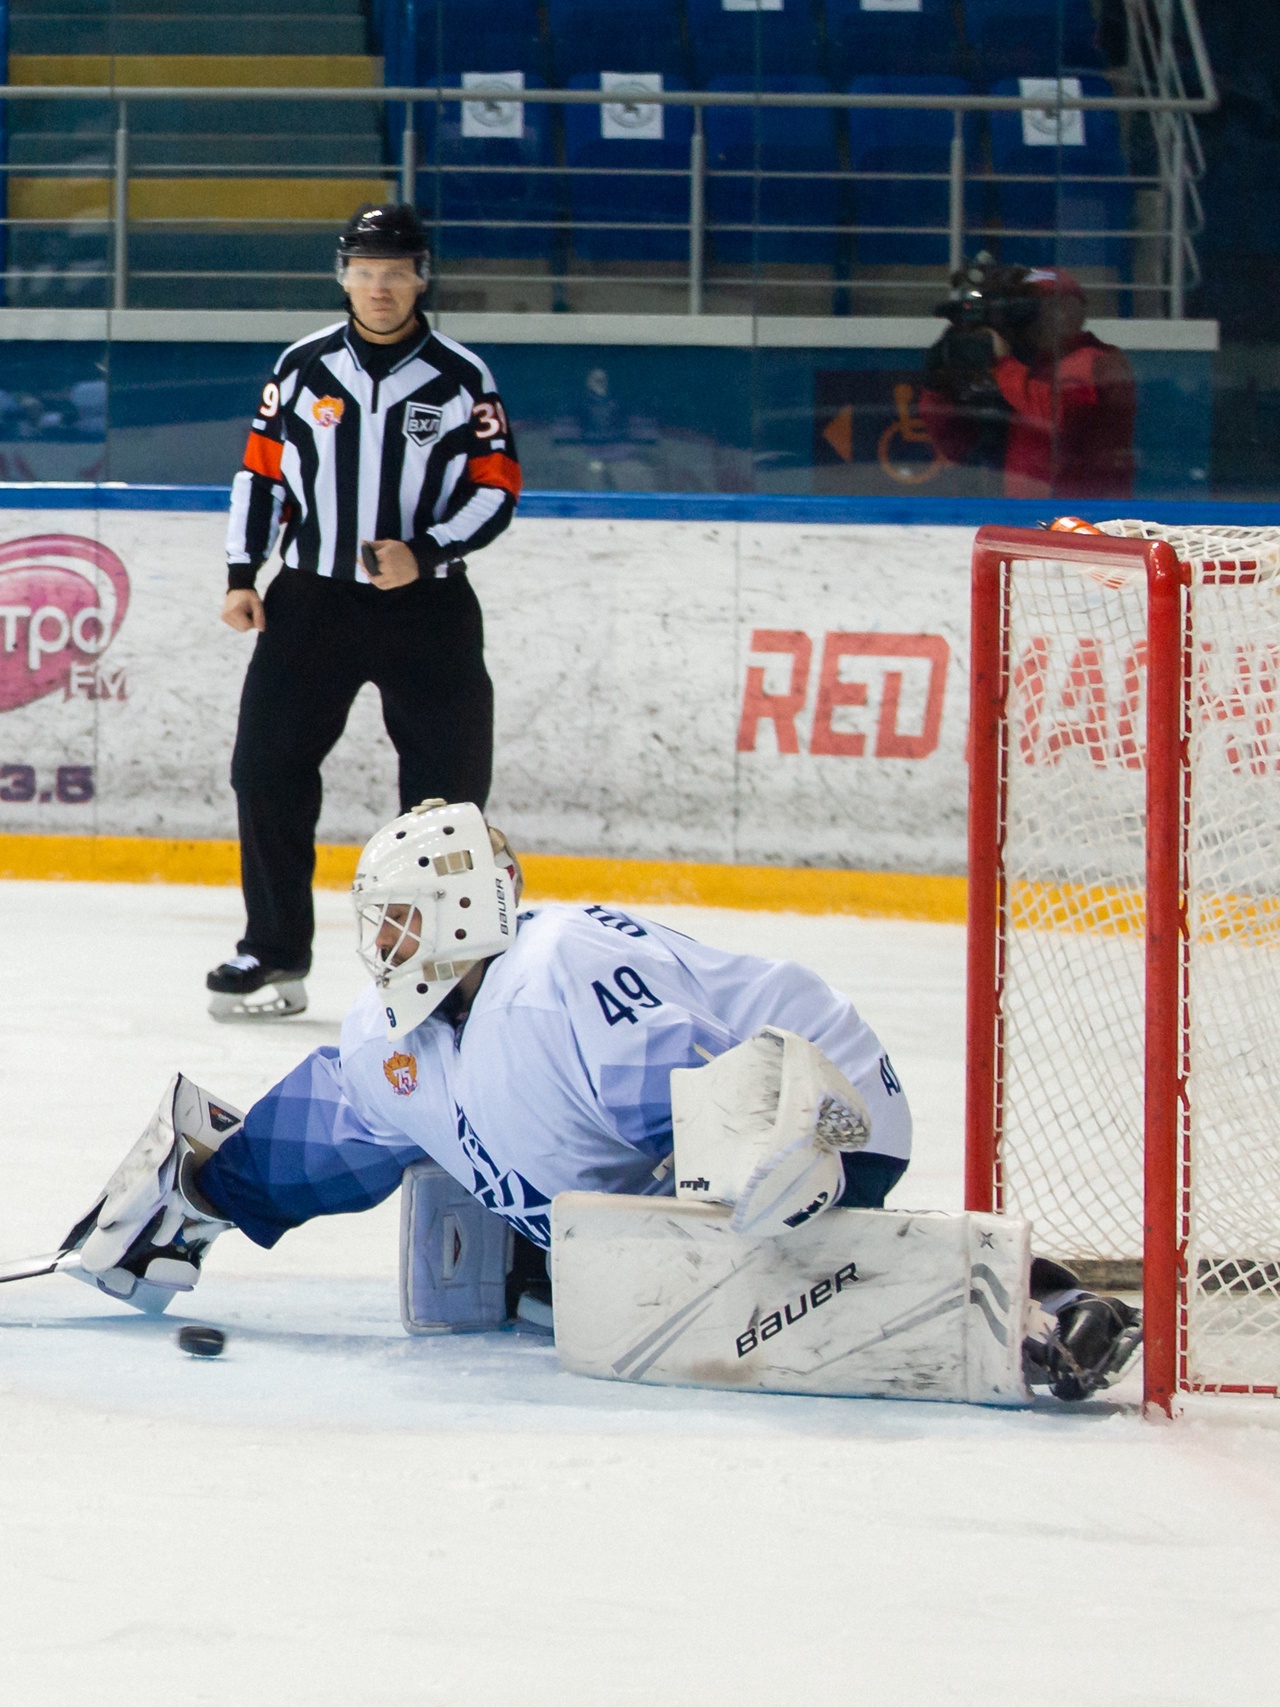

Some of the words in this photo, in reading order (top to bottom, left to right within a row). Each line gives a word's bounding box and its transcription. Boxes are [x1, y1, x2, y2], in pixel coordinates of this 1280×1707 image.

[70, 661, 128, 700] FM
[735, 628, 951, 760] RED
[590, 965, 663, 1027] 49
